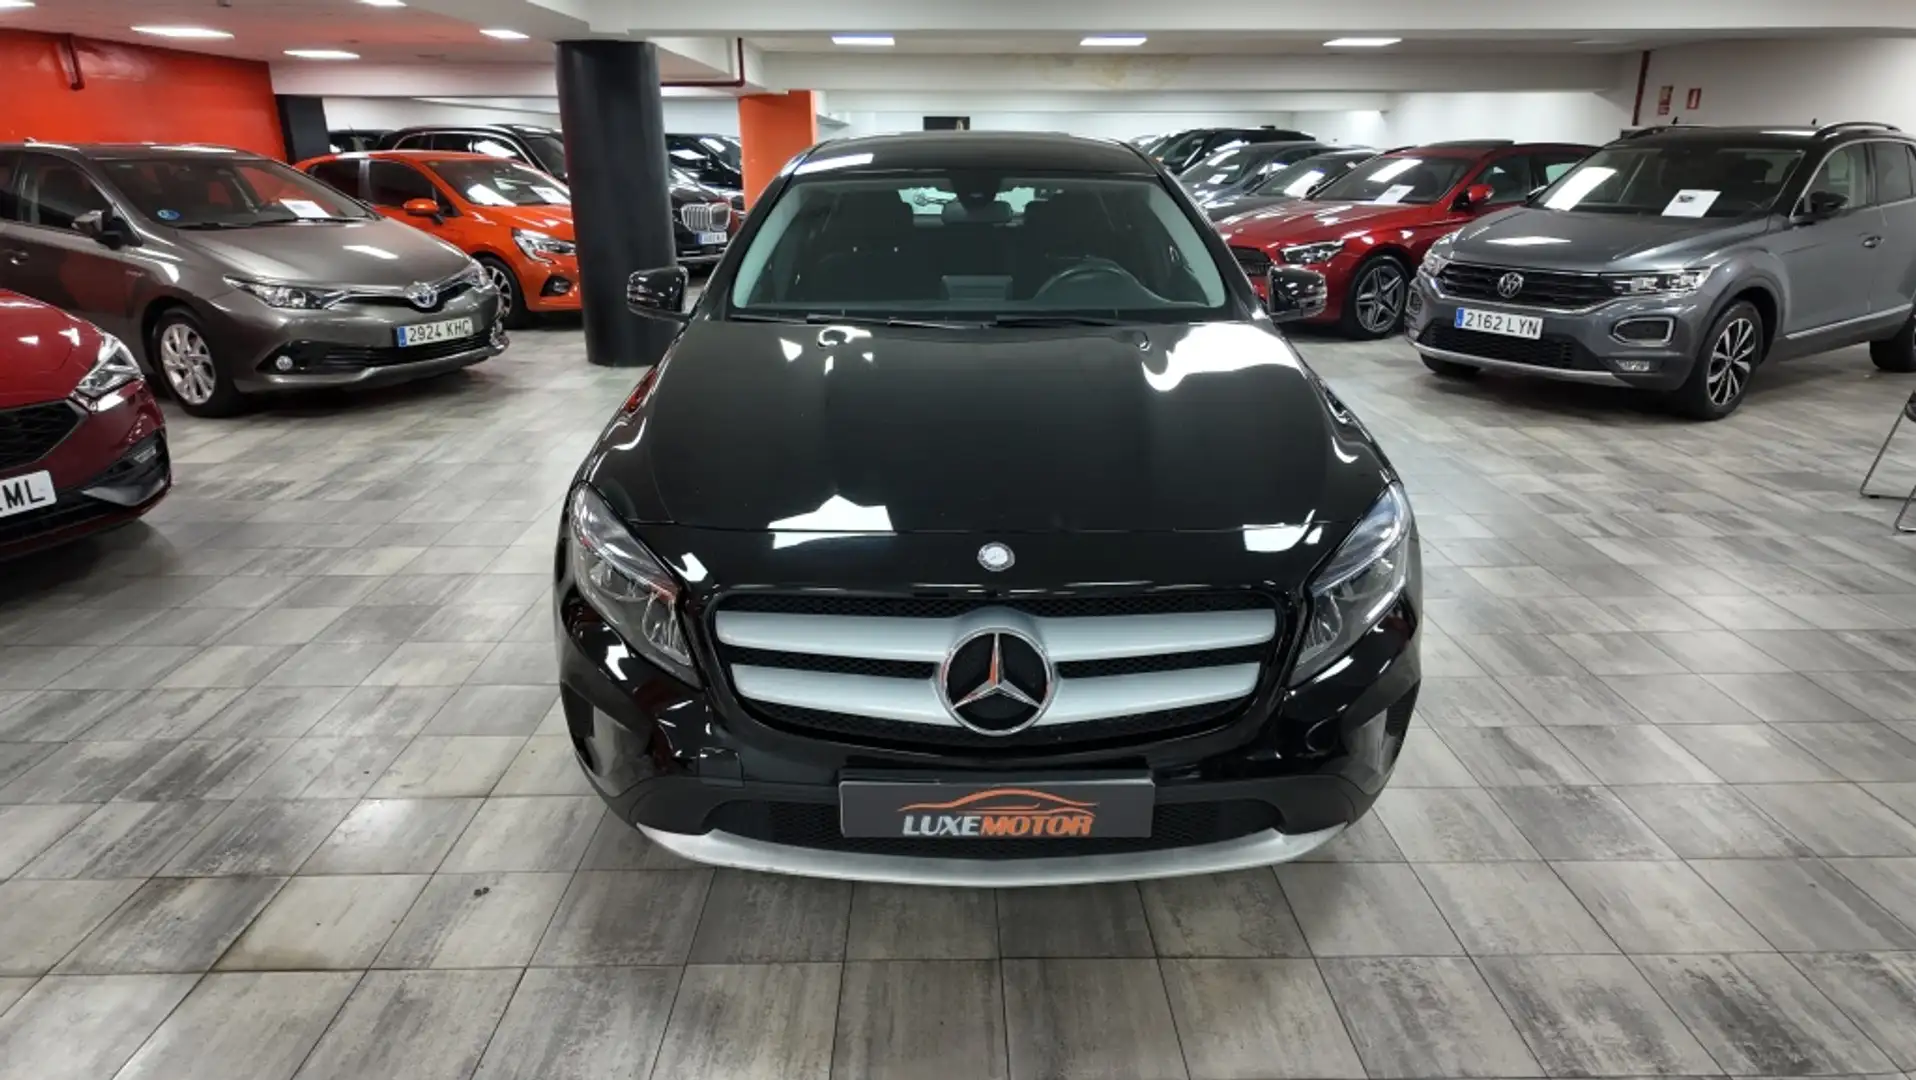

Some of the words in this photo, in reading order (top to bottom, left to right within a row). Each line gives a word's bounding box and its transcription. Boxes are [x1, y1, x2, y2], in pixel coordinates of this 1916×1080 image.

[409, 325, 442, 342] 2924
[446, 319, 470, 336] KHC
[1465, 312, 1503, 331] 2162
[1506, 317, 1540, 336] LYN
[0, 479, 46, 511] ML
[902, 814, 1096, 837] LUXEMOTOR
